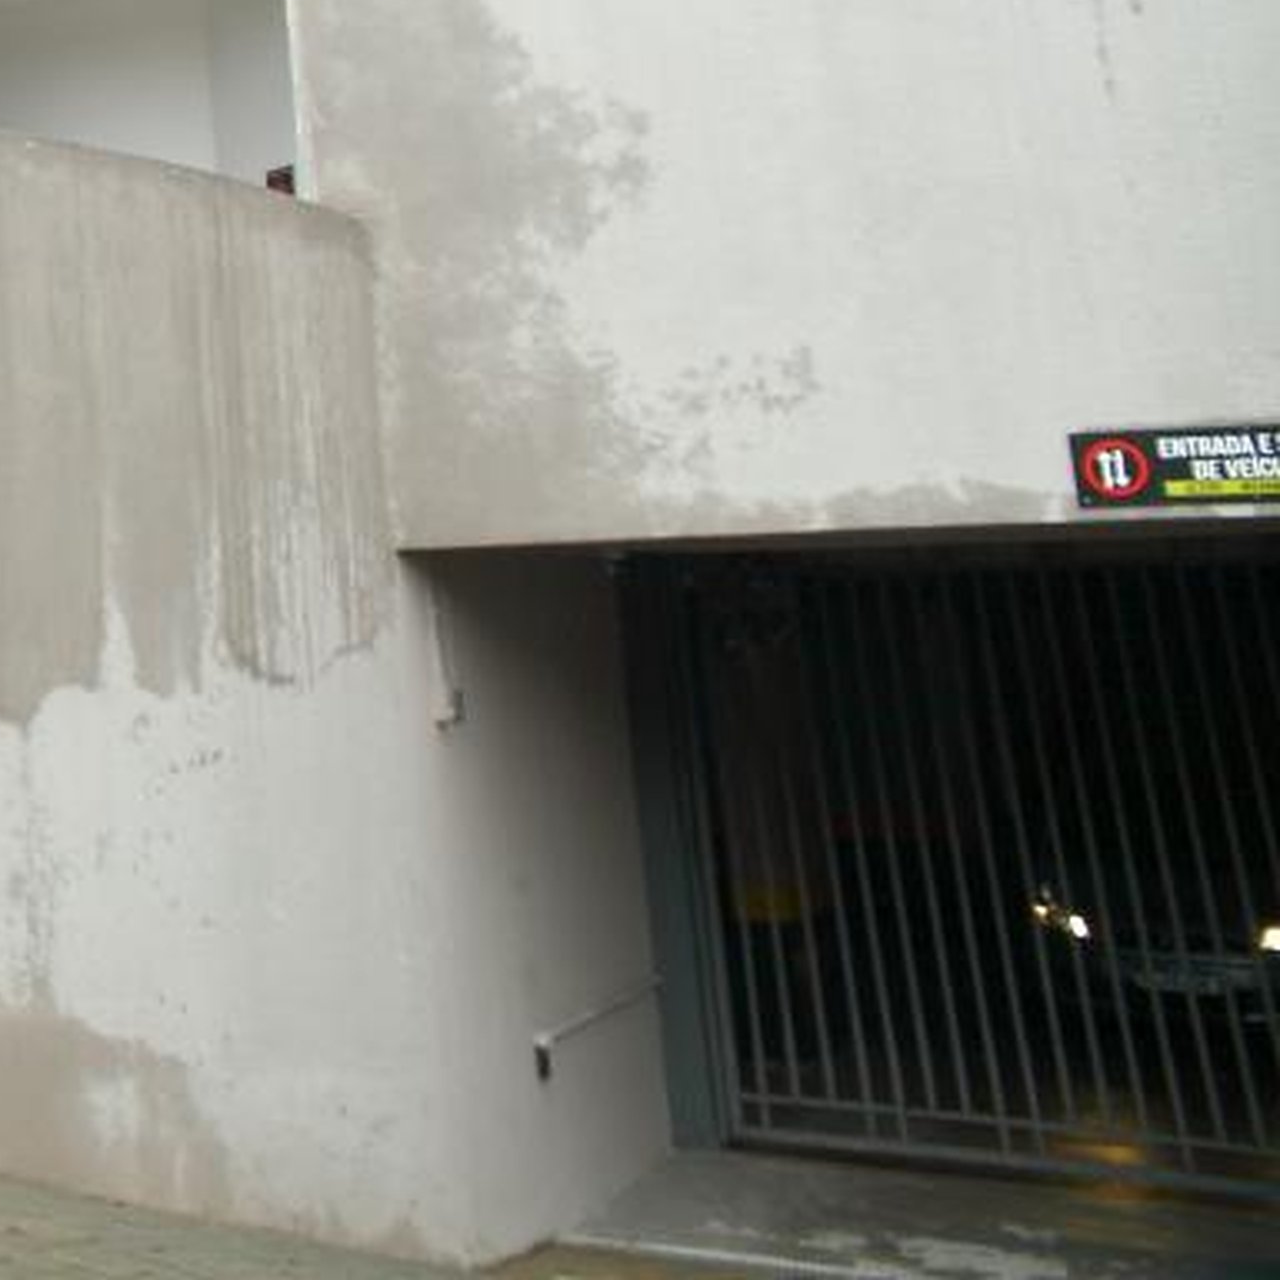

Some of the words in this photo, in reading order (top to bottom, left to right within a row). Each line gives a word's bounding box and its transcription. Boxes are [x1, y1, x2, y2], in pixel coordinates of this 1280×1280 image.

[1157, 434, 1255, 458] ENTRADA
[1258, 431, 1275, 454] E
[1193, 459, 1223, 481] DE
